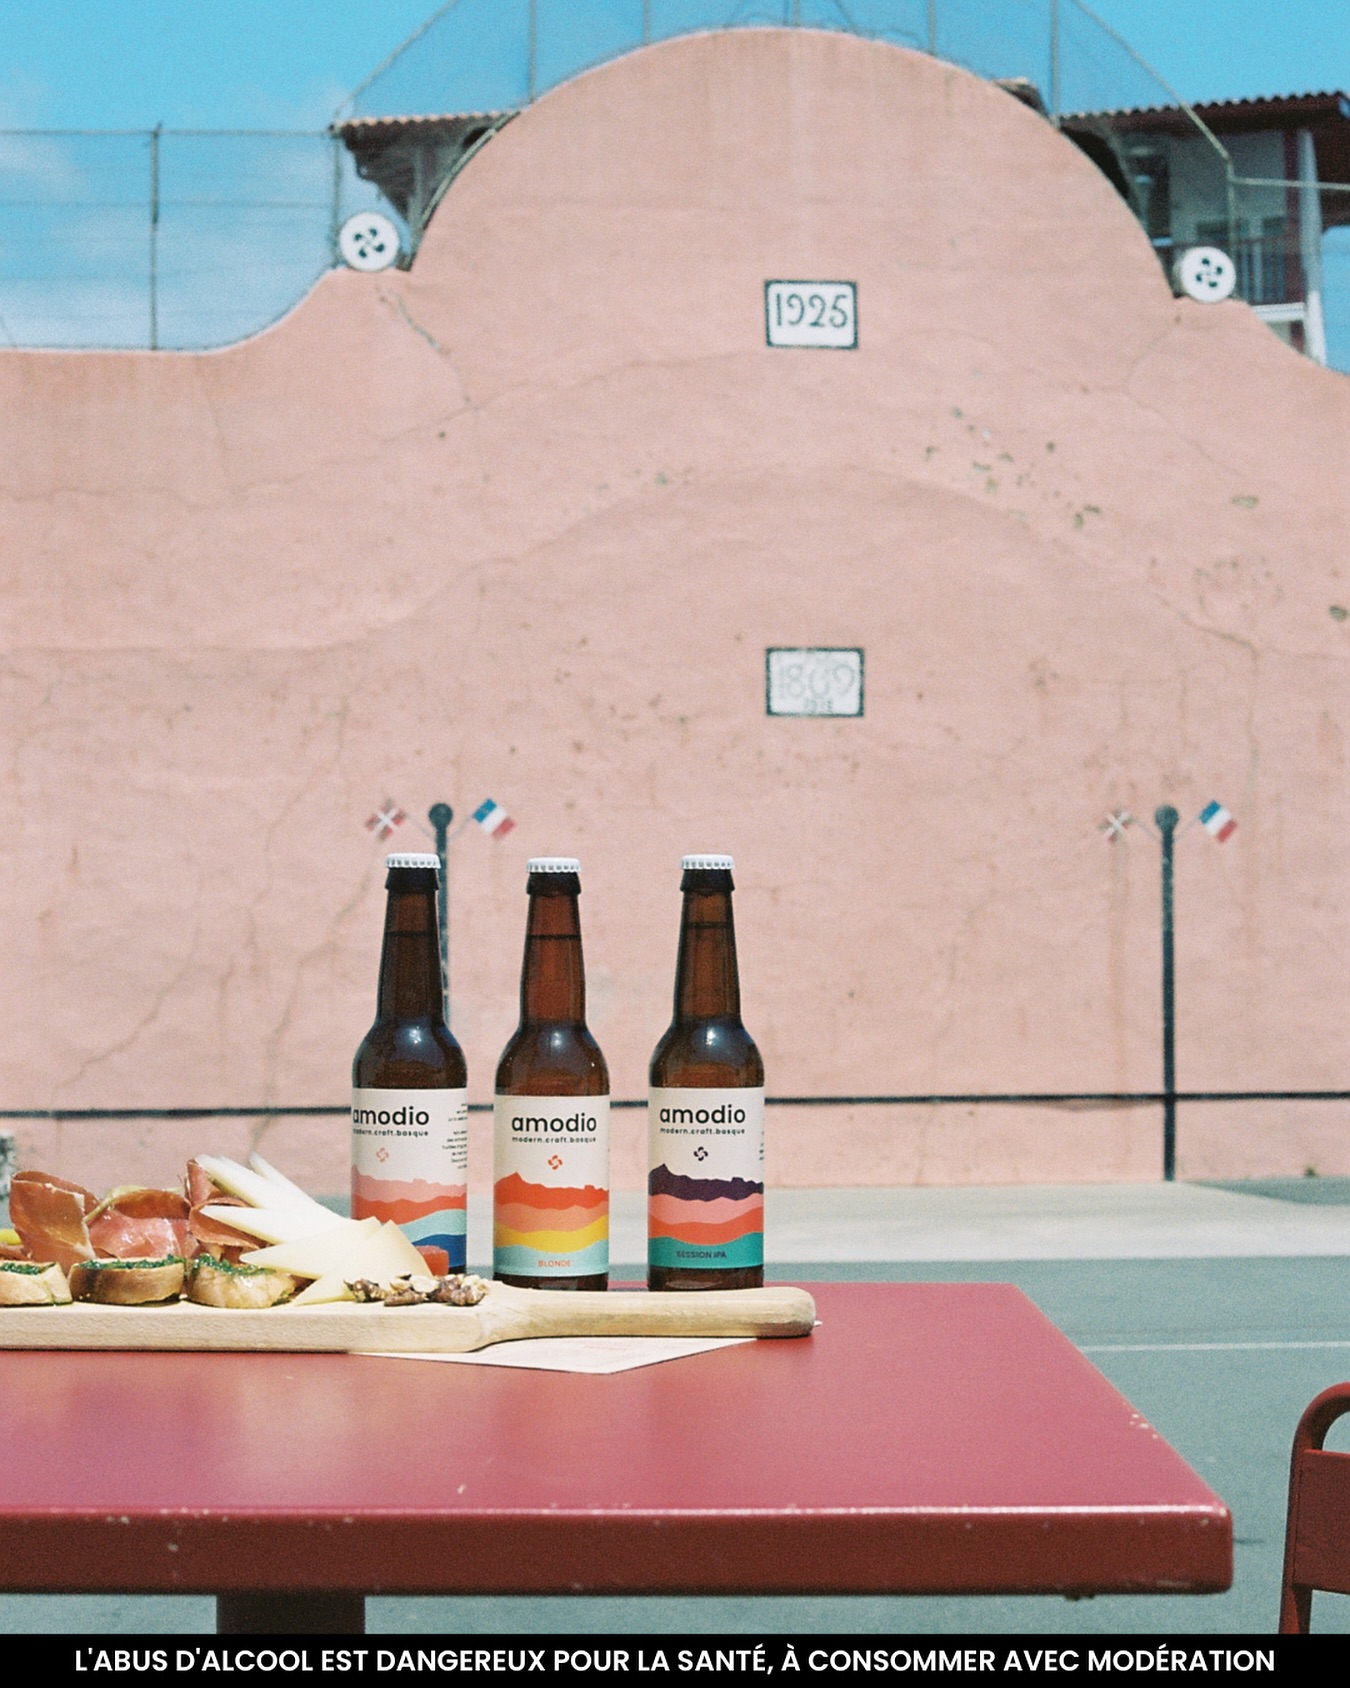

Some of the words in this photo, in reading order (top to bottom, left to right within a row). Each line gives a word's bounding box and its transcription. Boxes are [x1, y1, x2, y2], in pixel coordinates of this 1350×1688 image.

[776, 293, 848, 328] 1925
[352, 1105, 430, 1126] amodio
[660, 1104, 746, 1124] amodio
[511, 1112, 597, 1133] amodio
[659, 1127, 746, 1136] modern.craft.basque
[511, 1136, 597, 1144] modern.craft.basque
[676, 1250, 712, 1259] SESSION
[713, 1250, 727, 1259] IPA
[537, 1260, 572, 1268] BLONDE
